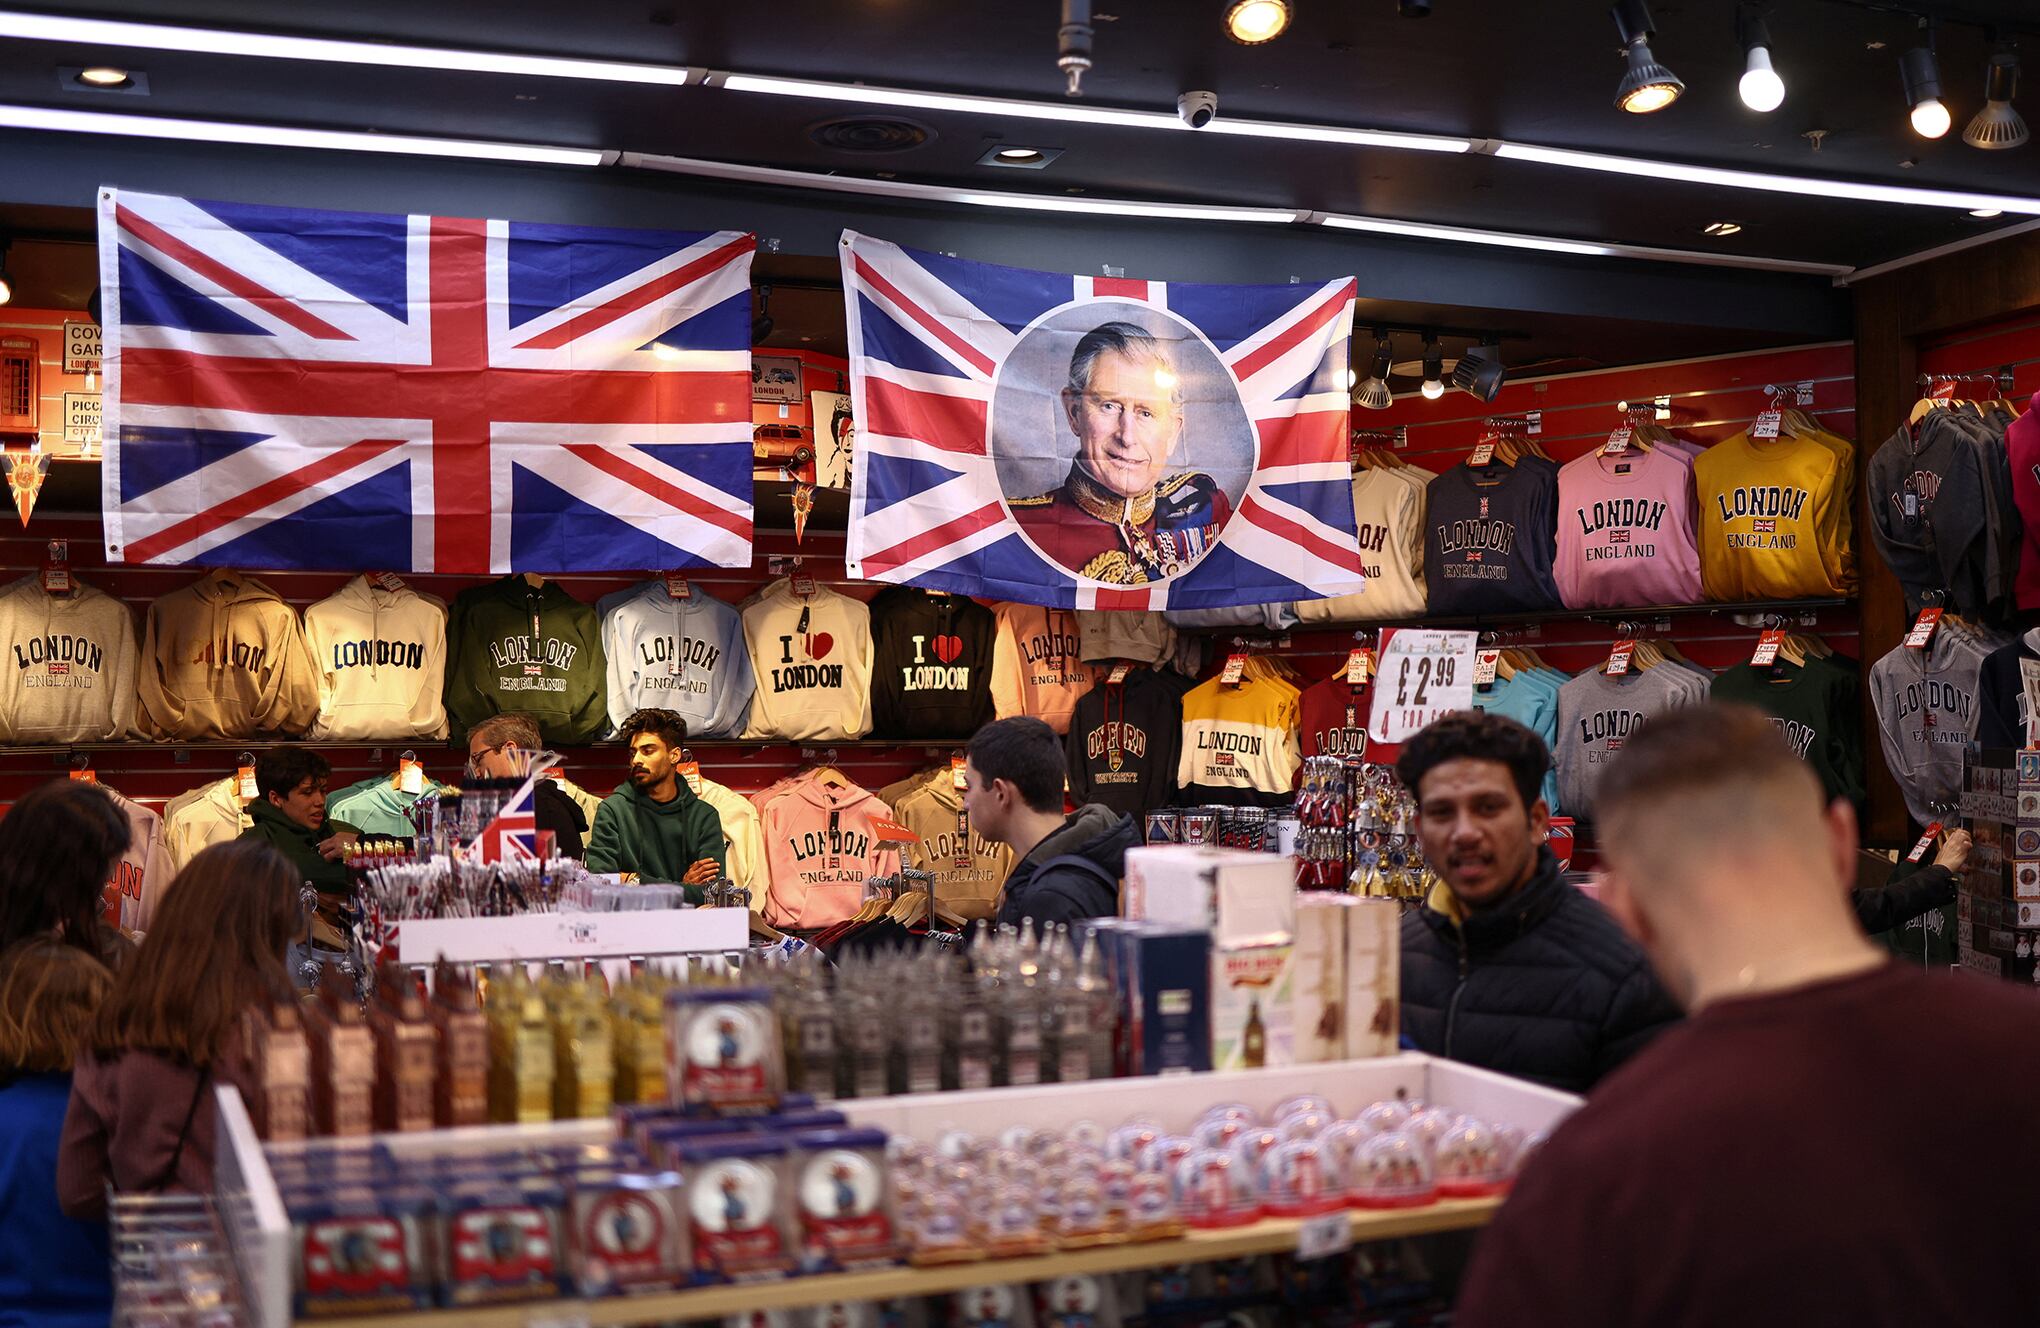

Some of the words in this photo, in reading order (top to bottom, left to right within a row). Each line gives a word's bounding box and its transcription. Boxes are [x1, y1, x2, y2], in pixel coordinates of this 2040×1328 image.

[71, 343, 103, 356] GAR
[754, 387, 785, 396] LONDON
[1577, 498, 1667, 535] LONDON
[1717, 486, 1808, 522] LONDON
[1438, 519, 1516, 555] LONDON
[1727, 533, 1797, 550] ENGLAND
[1586, 544, 1656, 561] ENGLAND
[1443, 563, 1508, 580] ENGLAND
[14, 633, 103, 673] LONDON
[333, 638, 424, 670] LONDON
[779, 635, 793, 663] I
[913, 635, 925, 664] I
[26, 674, 93, 689] ENGLAND
[500, 676, 567, 692] ENGLAND
[772, 664, 843, 693] LONDON
[903, 666, 970, 691] LONDON
[1396, 656, 1456, 707] £2.99
[1381, 710, 1389, 739] 4
[1402, 709, 1424, 728] FOR
[1580, 709, 1649, 745] LONDO
[1197, 730, 1262, 756] LONDON
[1205, 765, 1250, 779] ENGLAND
[794, 830, 869, 861] LONDON
[923, 831, 1001, 862] LONON
[799, 870, 863, 884] ENGLAND
